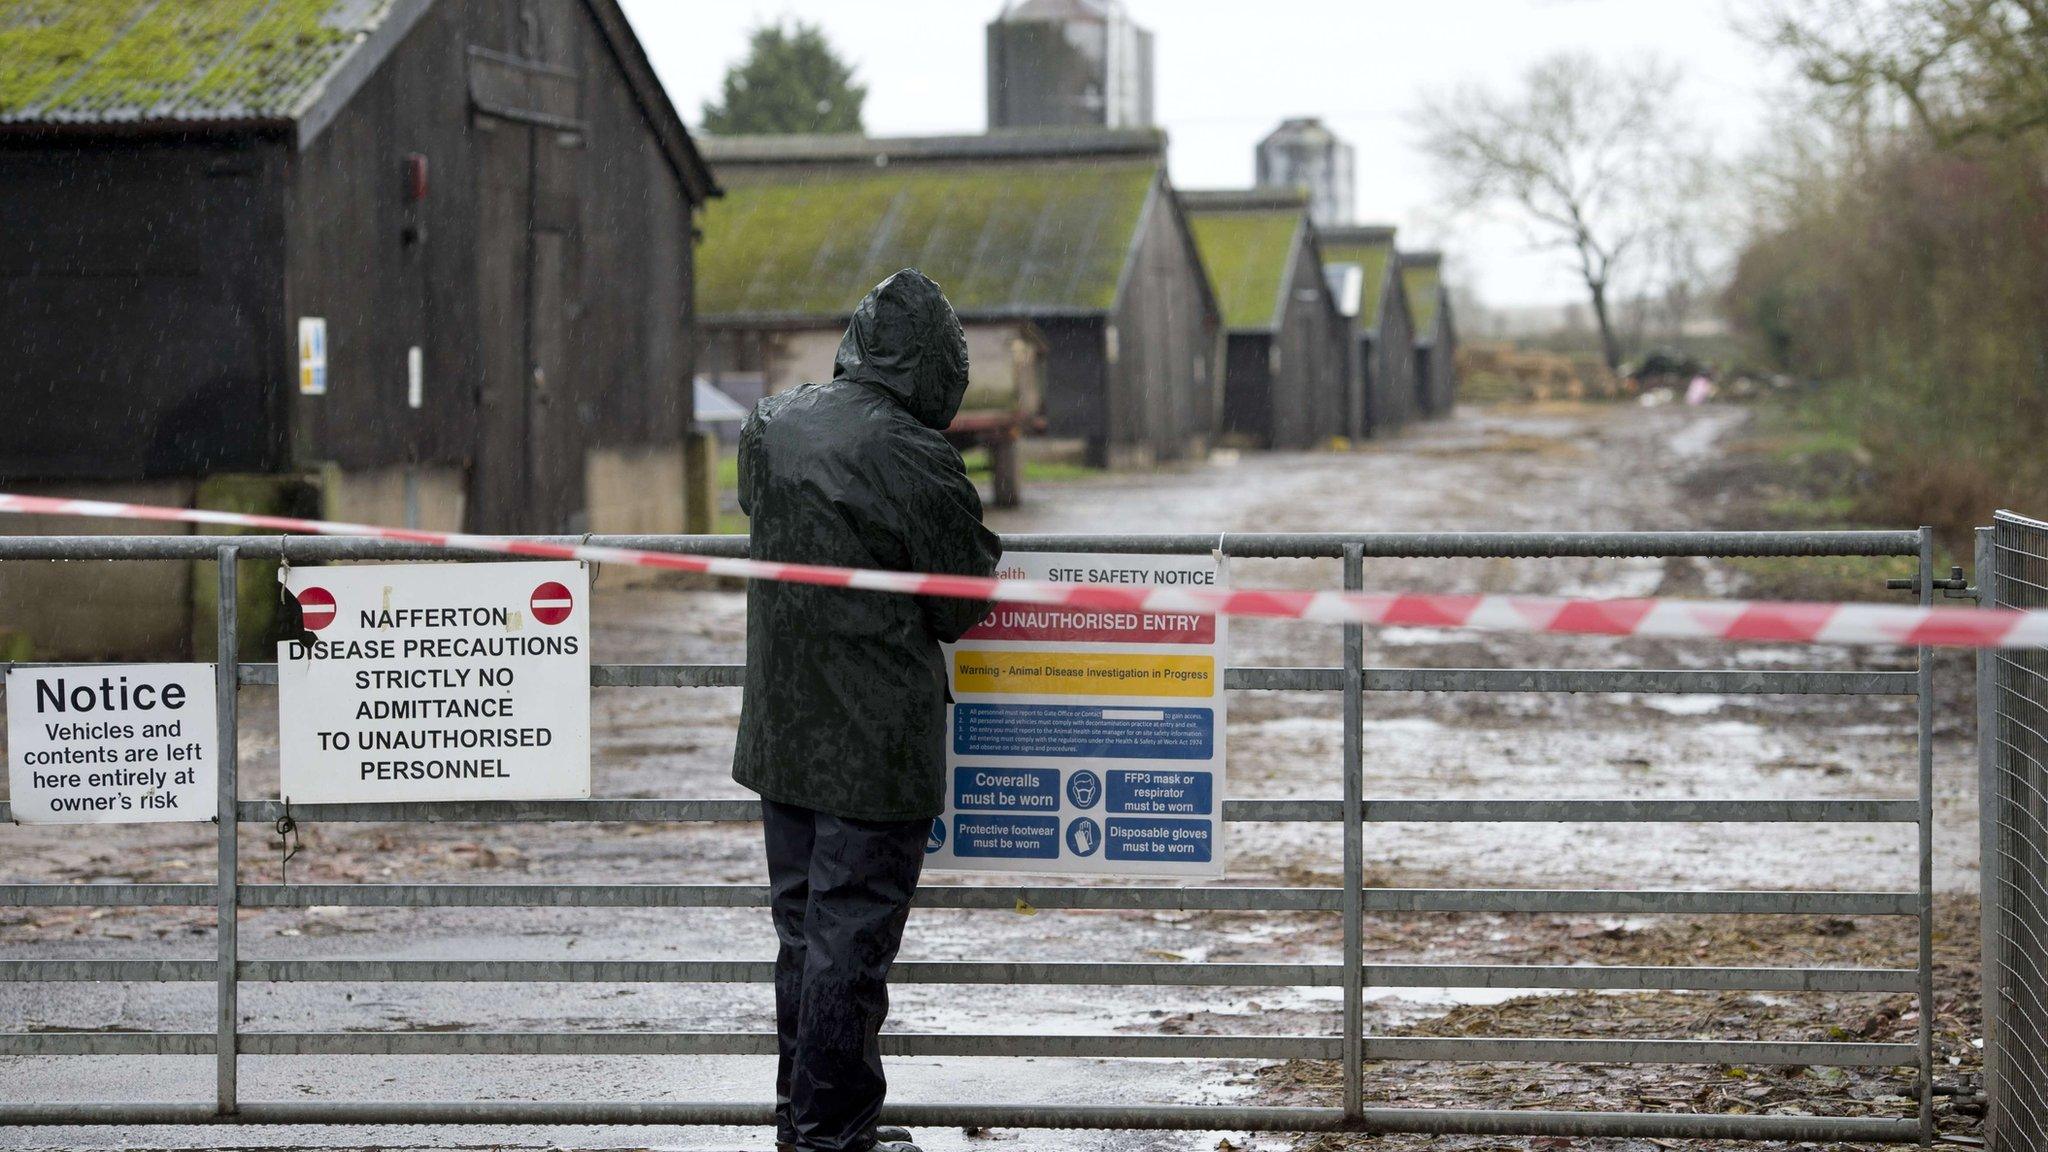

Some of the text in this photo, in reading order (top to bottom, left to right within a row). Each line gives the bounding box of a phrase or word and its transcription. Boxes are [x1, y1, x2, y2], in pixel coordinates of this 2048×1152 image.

[994, 568, 1025, 580] ealth
[1049, 568, 1214, 584] SITE SAFETY NOTICE
[360, 607, 508, 629] NAFFERTON
[1002, 612, 1138, 630] UNAUTHORISED
[1143, 615, 1200, 631] ENTRY
[289, 635, 579, 661] DISEASE PRECAUTIONS
[355, 667, 514, 689] STRICTLY NO
[960, 665, 999, 676] Warning
[1009, 665, 1042, 676] Animal
[1045, 666, 1084, 676] Disease
[1087, 667, 1149, 680] Investigation
[1152, 669, 1161, 678] in
[1164, 669, 1208, 681] Progress
[37, 676, 186, 713] Notice
[356, 699, 513, 720] ADMITTANCE
[45, 720, 181, 740] Vehicles and
[318, 728, 552, 750] TO UNAUTHORISED
[24, 743, 202, 765] contents are left
[360, 759, 510, 780] PERSONNEL
[33, 768, 195, 790] here entirely at
[976, 773, 1040, 787] Coveralls
[1125, 773, 1150, 784] FFP3
[1153, 774, 1179, 784] mask
[50, 790, 179, 810] owner's risk
[962, 793, 1053, 806] must be worn
[1134, 788, 1184, 799] respirator
[1125, 801, 1193, 812] must be worn
[960, 824, 1054, 836] Protective footwear
[1110, 826, 1207, 841] Disposable gloves
[974, 838, 1040, 849] must be worn
[1123, 842, 1194, 853] must be worn
